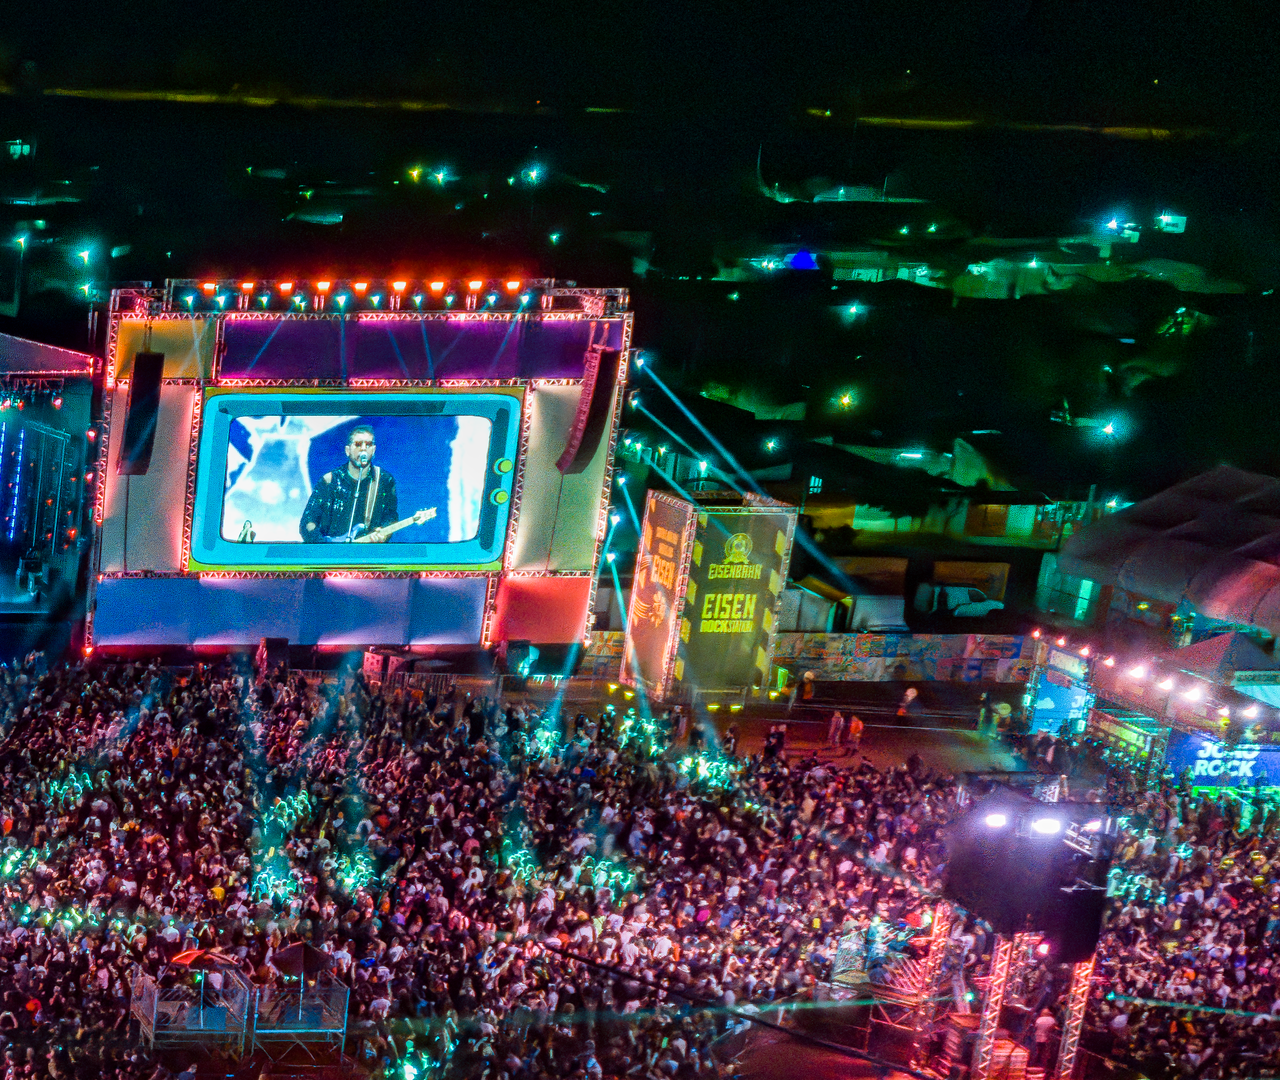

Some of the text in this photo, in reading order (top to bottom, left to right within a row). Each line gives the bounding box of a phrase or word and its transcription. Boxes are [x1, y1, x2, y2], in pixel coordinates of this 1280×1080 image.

[708, 563, 763, 580] EISENBAHN
[701, 593, 758, 619] EISEN
[1194, 759, 1257, 777] ROCK
